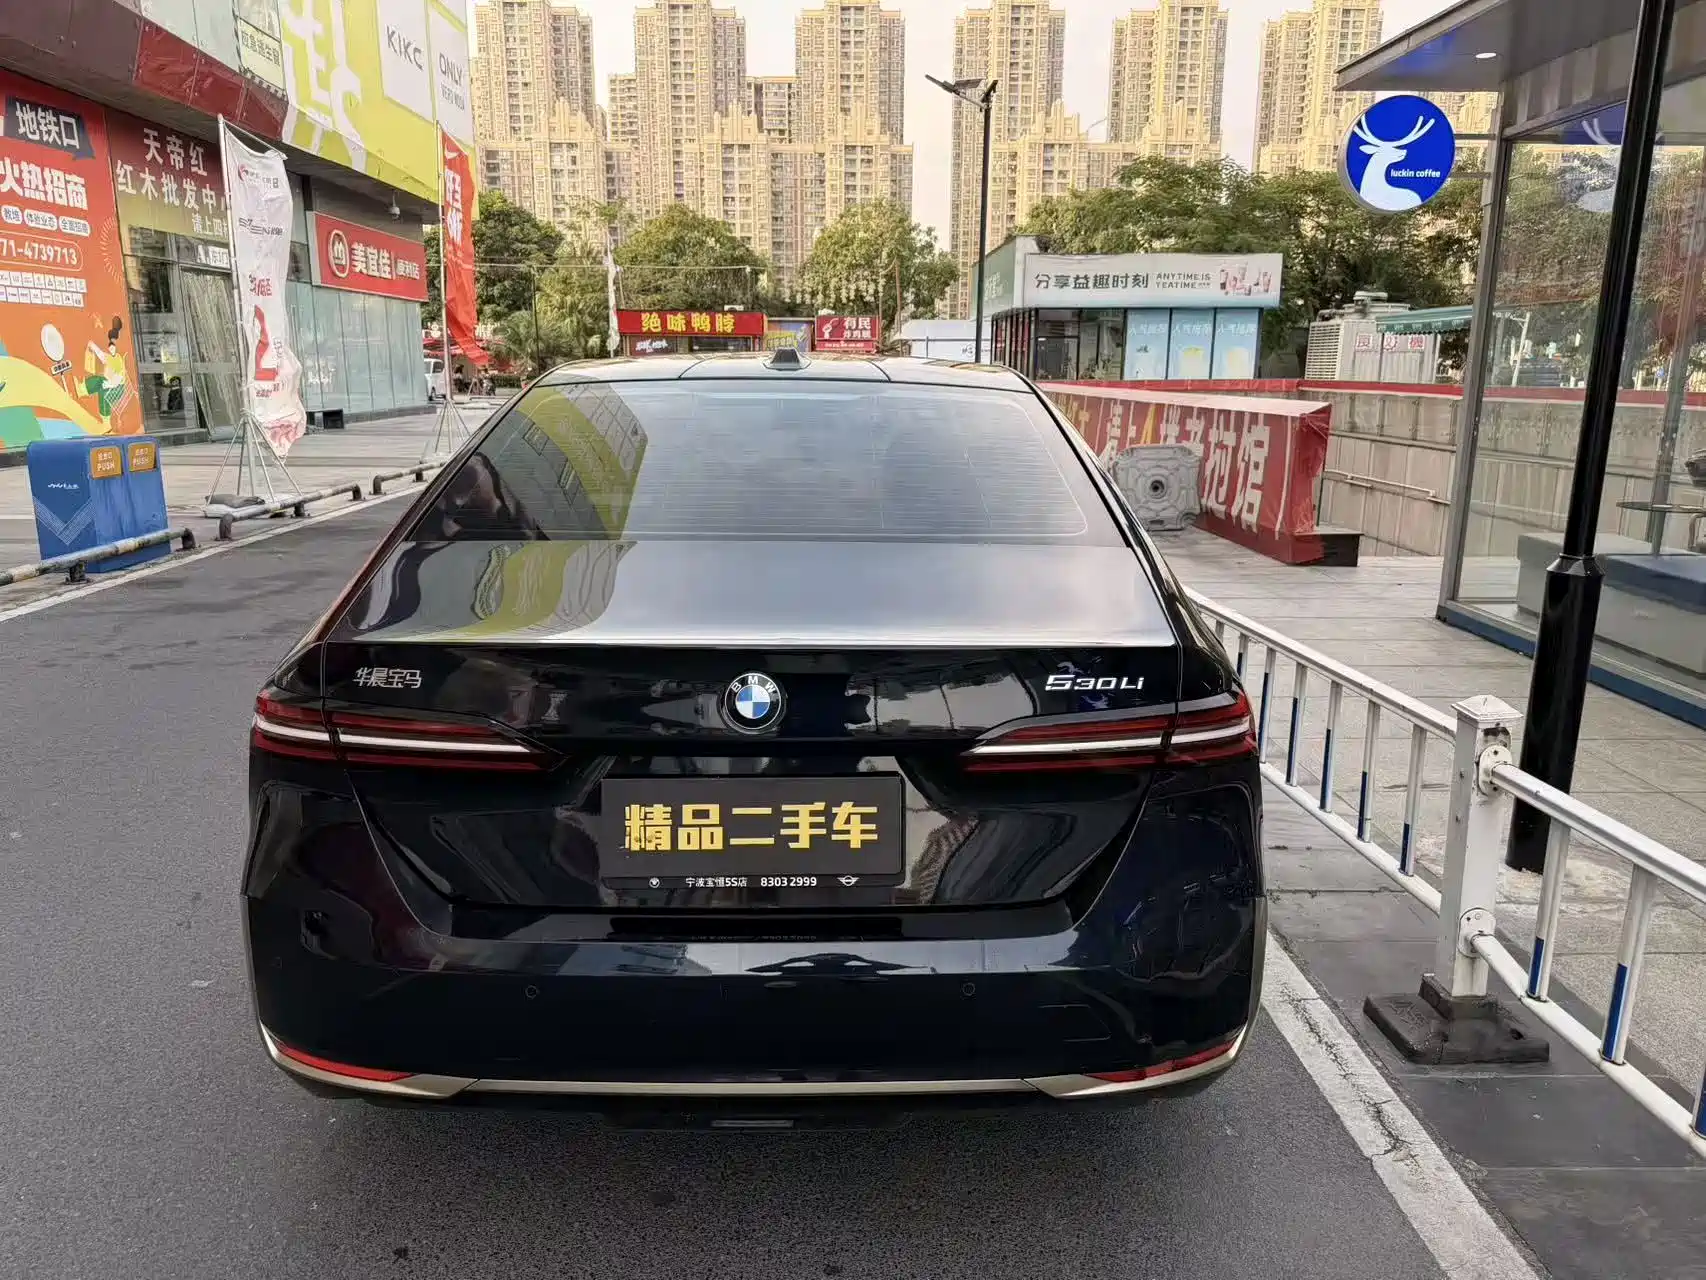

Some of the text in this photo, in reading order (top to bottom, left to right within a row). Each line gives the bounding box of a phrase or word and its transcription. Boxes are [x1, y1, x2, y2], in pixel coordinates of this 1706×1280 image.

[386, 25, 423, 71] KIKC
[439, 52, 463, 87] ONLY
[16, 102, 80, 149] 地铁口
[143, 128, 207, 176] 天帝红
[0, 156, 88, 211] 火热招商
[116, 160, 226, 213] 红木批发中
[1391, 169, 1441, 178] luckin coffee
[351, 241, 392, 279] 美宜佳
[1034, 272, 1149, 290] 分享益趣时刻
[1156, 272, 1199, 280] ANYTIME
[641, 312, 735, 333] 绝味鸭脖
[352, 667, 422, 689] 华晨宝马
[731, 675, 776, 693] BMW
[1045, 674, 1145, 691] 530Li
[624, 801, 878, 851] 精品二手车
[685, 876, 817, 888] 宁波宝恒5S店 8303 2999
